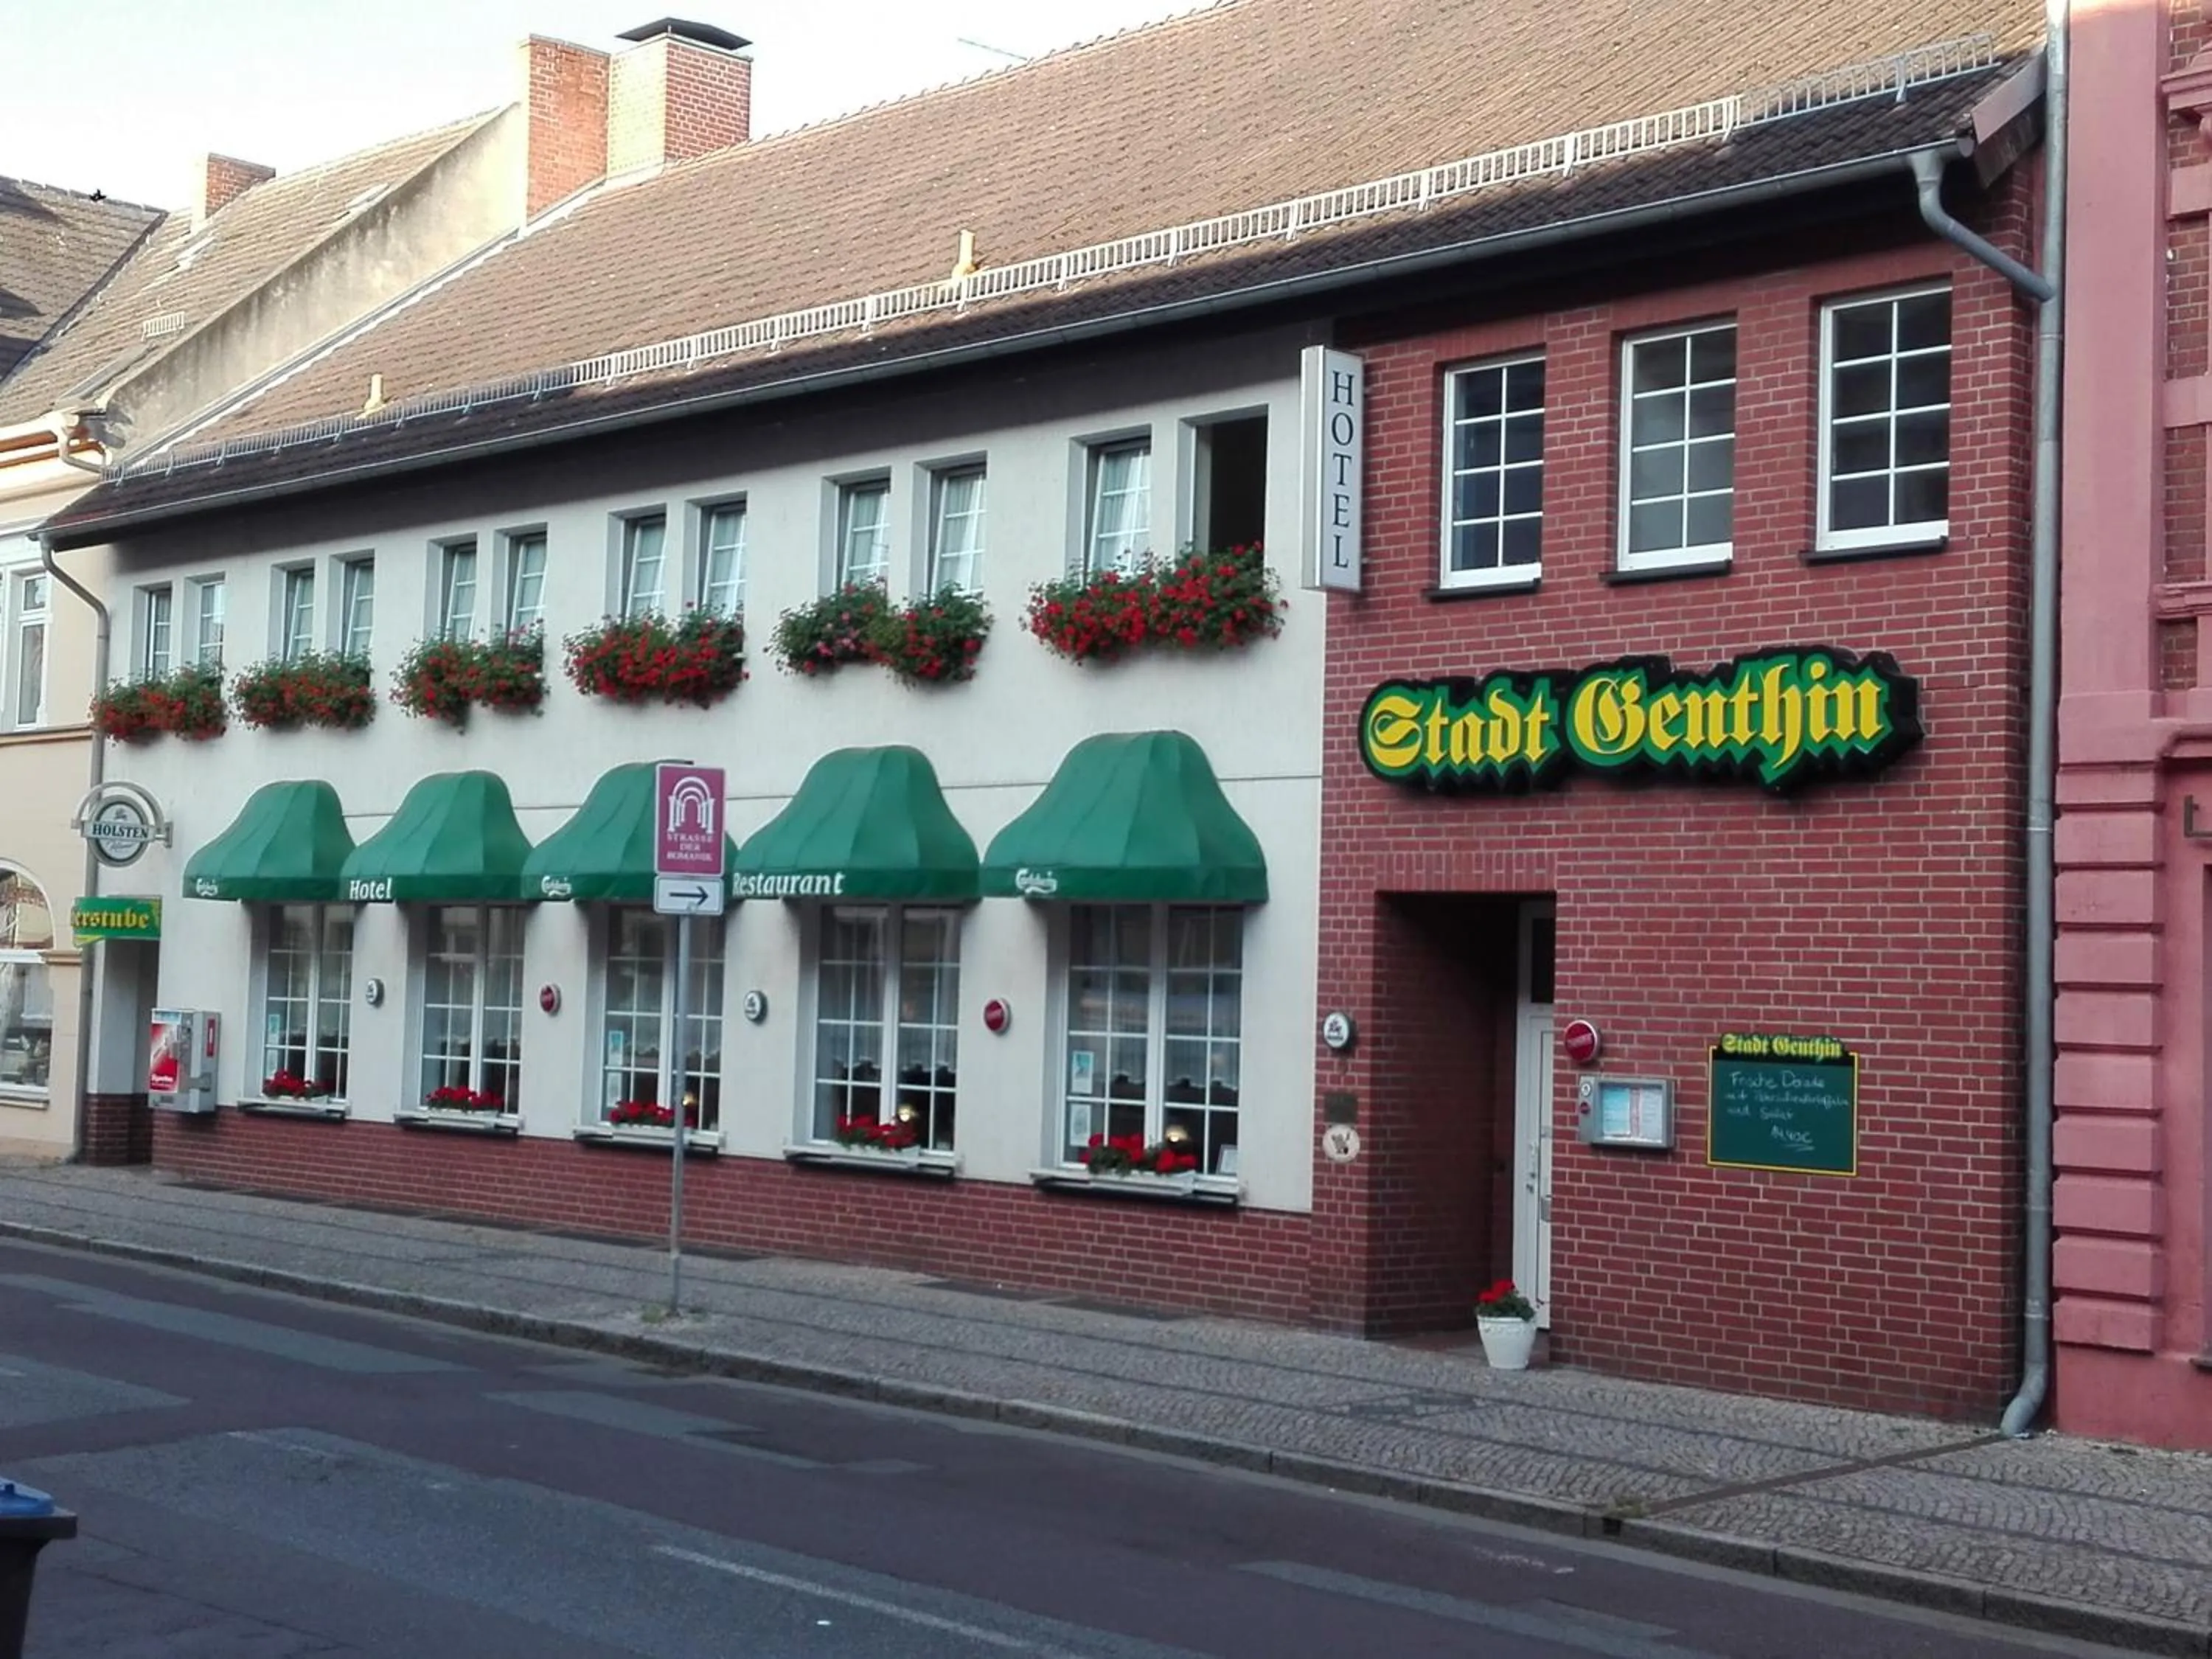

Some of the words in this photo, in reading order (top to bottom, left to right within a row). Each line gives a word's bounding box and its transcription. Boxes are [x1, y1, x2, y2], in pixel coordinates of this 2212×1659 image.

[1331, 370, 1355, 568] HOTEL
[1368, 686, 1551, 776] Stadt
[1573, 661, 1885, 771] Genthin
[92, 824, 148, 839] HOLSTEN
[667, 833, 713, 842] STRASSE
[667, 851, 713, 862] ROMANIK
[679, 843, 700, 851] DER
[349, 877, 392, 900] Hotel
[732, 871, 846, 896] Restaurant
[1722, 1033, 1769, 1054] Stadt
[1772, 1034, 1842, 1061] Genthin
